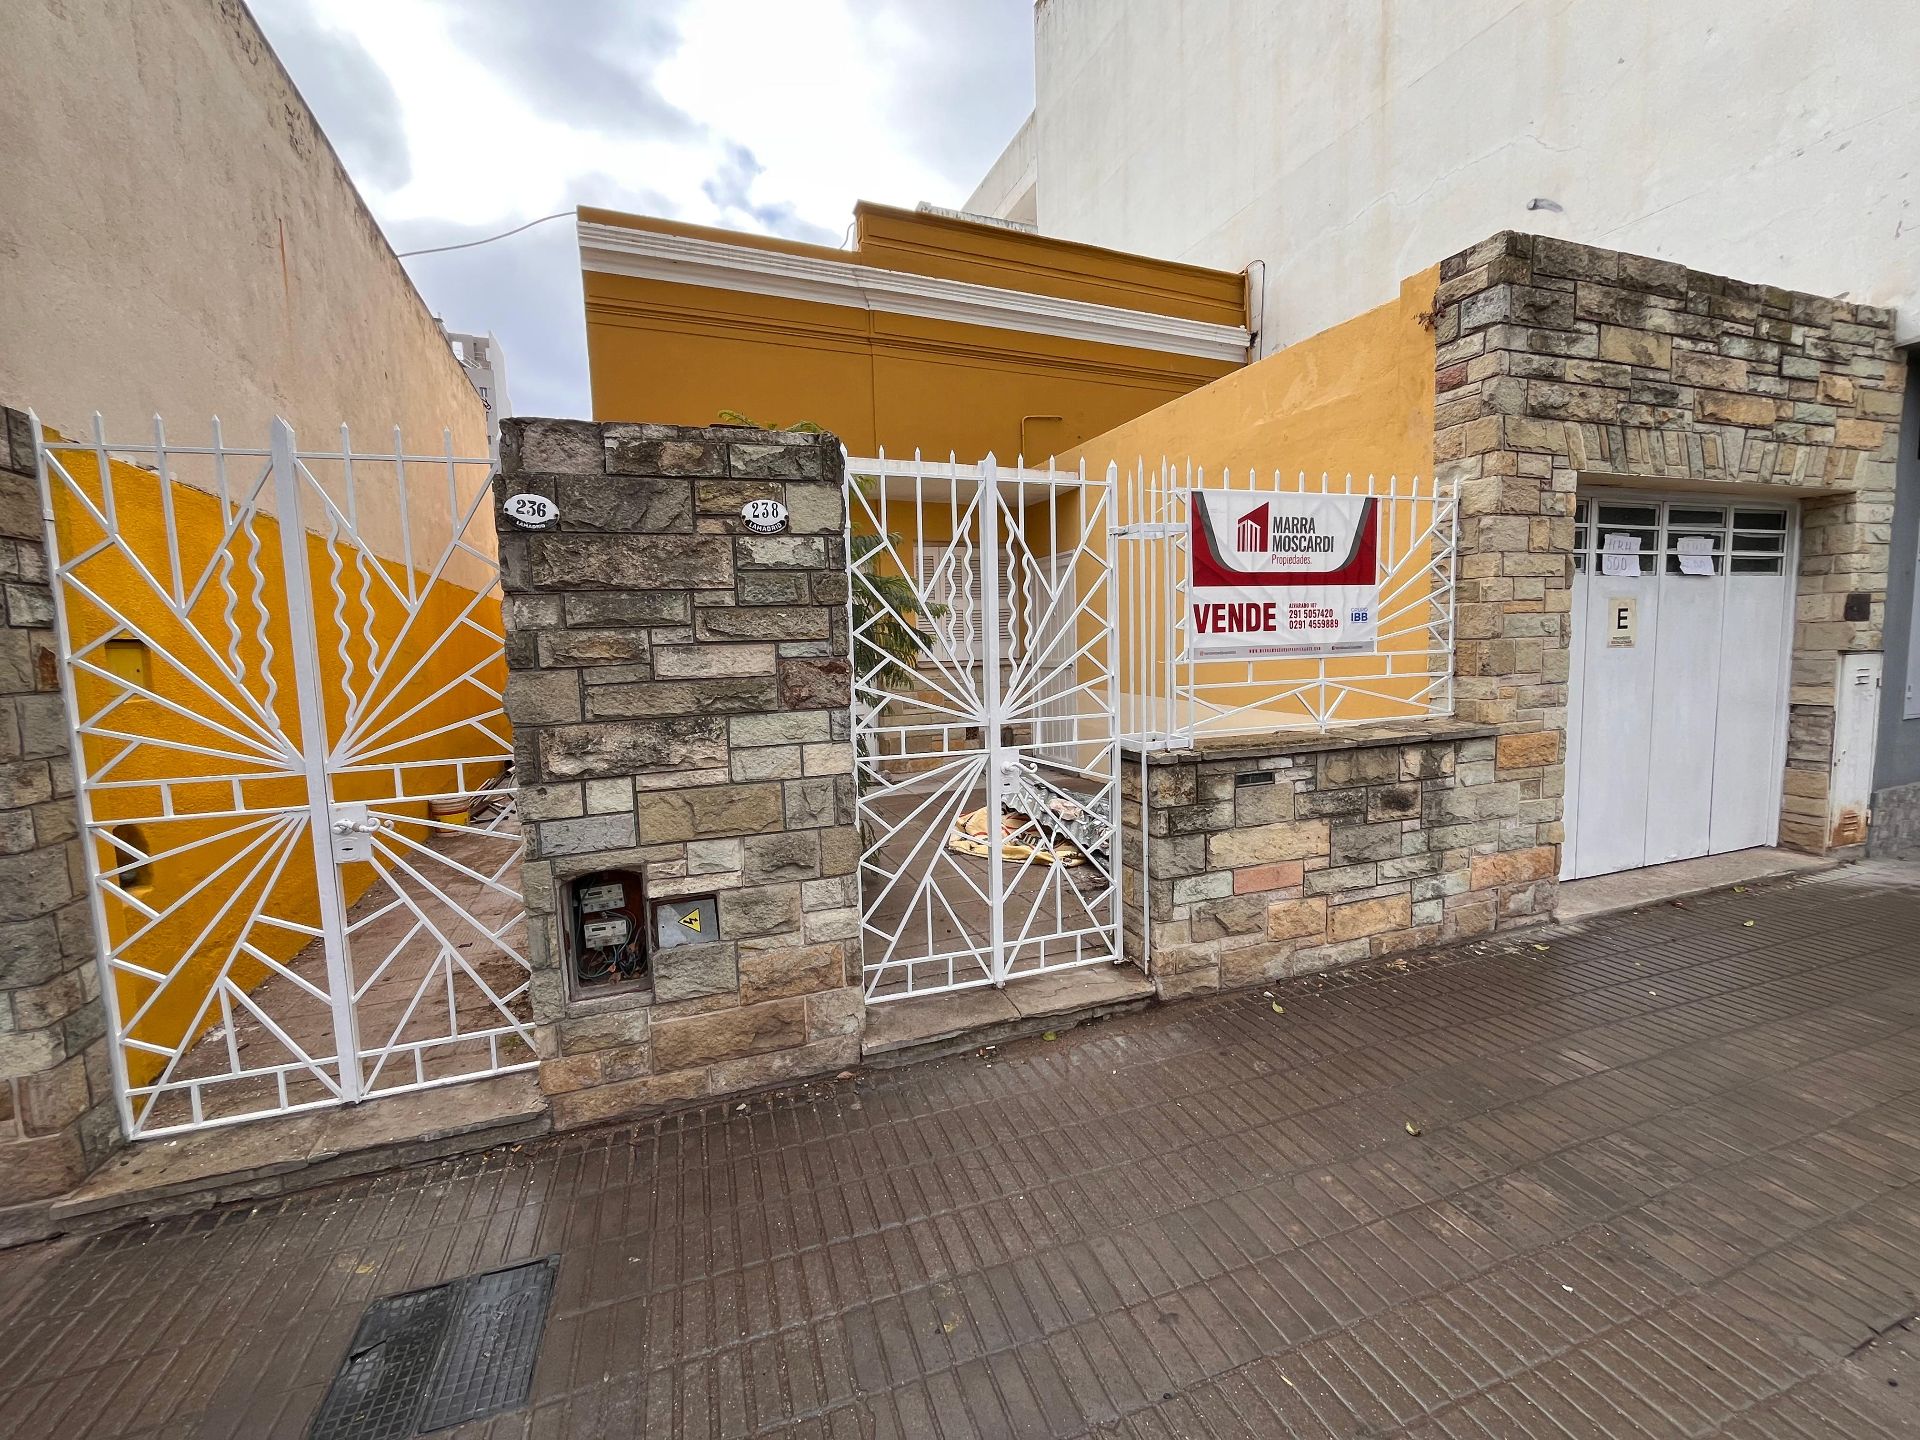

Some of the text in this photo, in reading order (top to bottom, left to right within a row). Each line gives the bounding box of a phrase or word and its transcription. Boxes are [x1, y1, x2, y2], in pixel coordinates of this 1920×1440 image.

[515, 499, 547, 518] 236
[752, 502, 779, 518] 238
[748, 522, 782, 532] LAMADRID
[1272, 516, 1316, 534] MARRA
[1272, 535, 1334, 553] MOSCARDI
[1193, 602, 1277, 634] VENDE
[1288, 608, 1333, 619] 291 5057420
[1350, 612, 1368, 622] IBB
[1617, 607, 1629, 630] E
[1289, 619, 1339, 630] 0291 4559889
